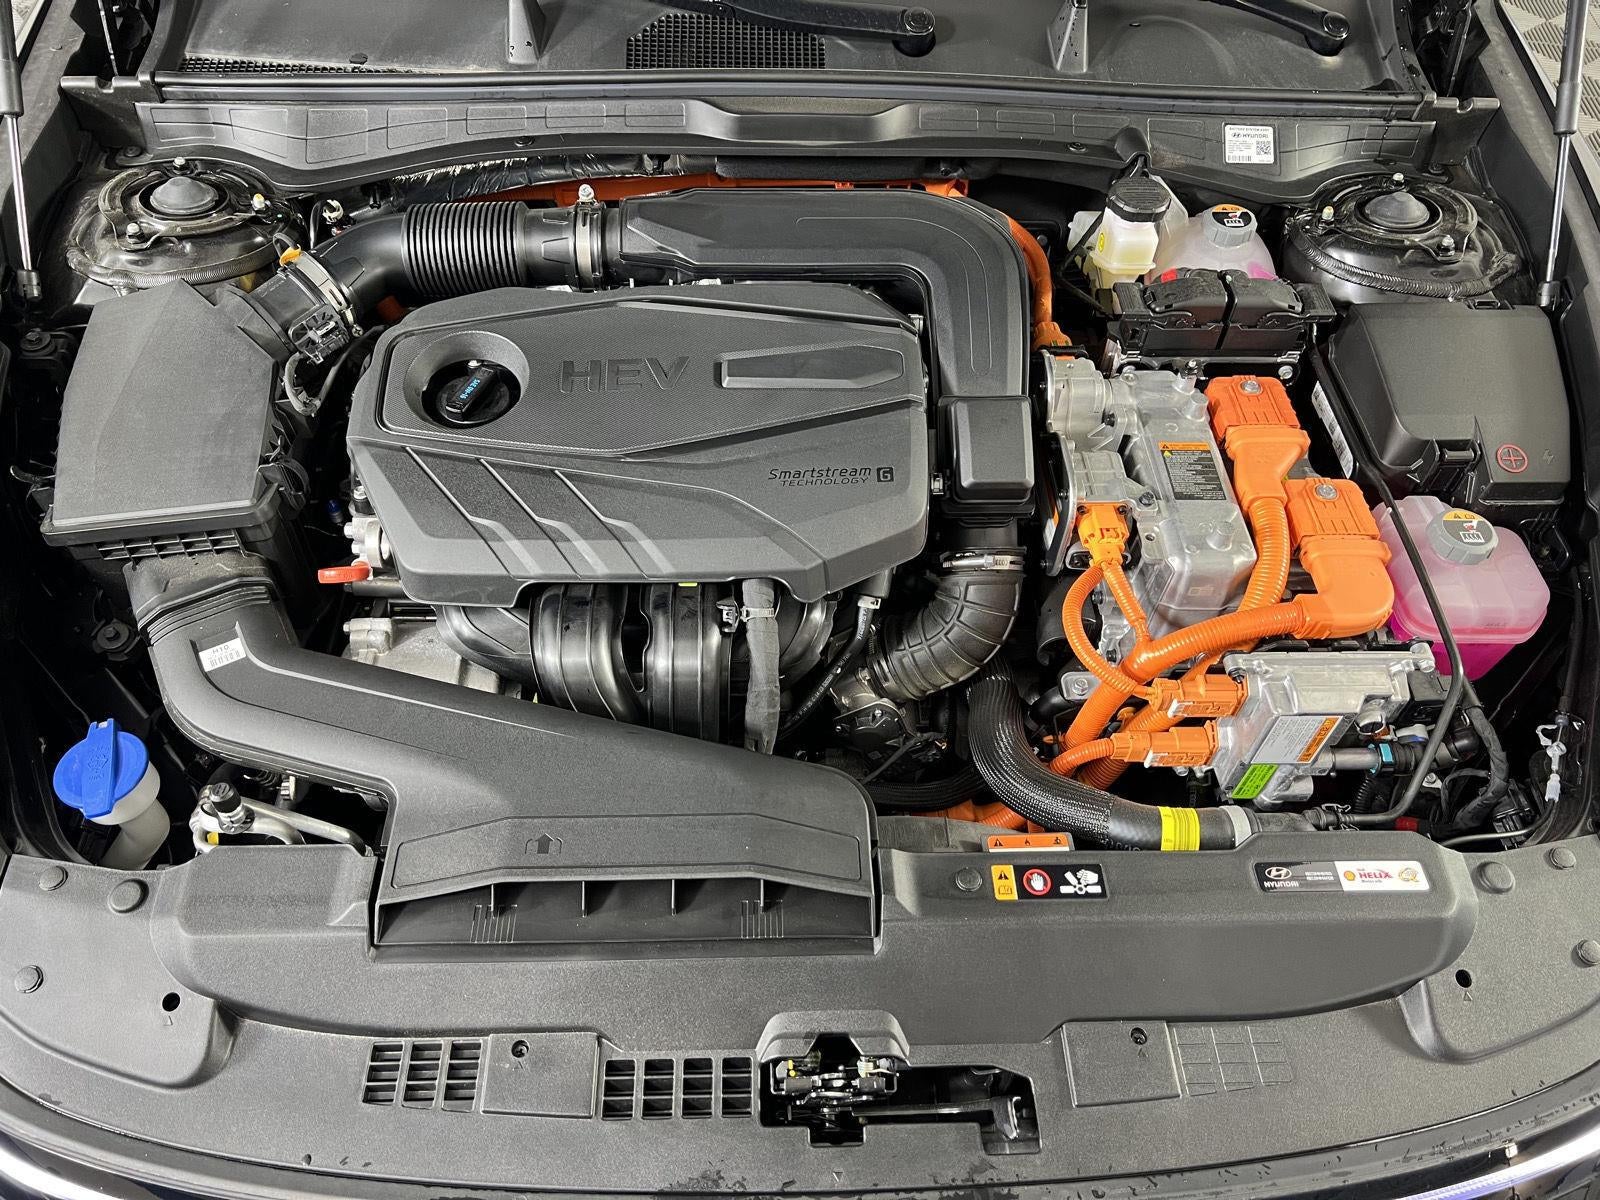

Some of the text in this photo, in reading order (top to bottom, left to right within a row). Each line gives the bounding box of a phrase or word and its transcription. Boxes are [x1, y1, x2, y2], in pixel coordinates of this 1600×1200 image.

[560, 356, 690, 393] HEV
[768, 466, 872, 480] Smartstream
[780, 476, 869, 487] TECHNOLOGY
[1358, 871, 1392, 879] HELIX
[1263, 880, 1299, 888] HYUNDAI
